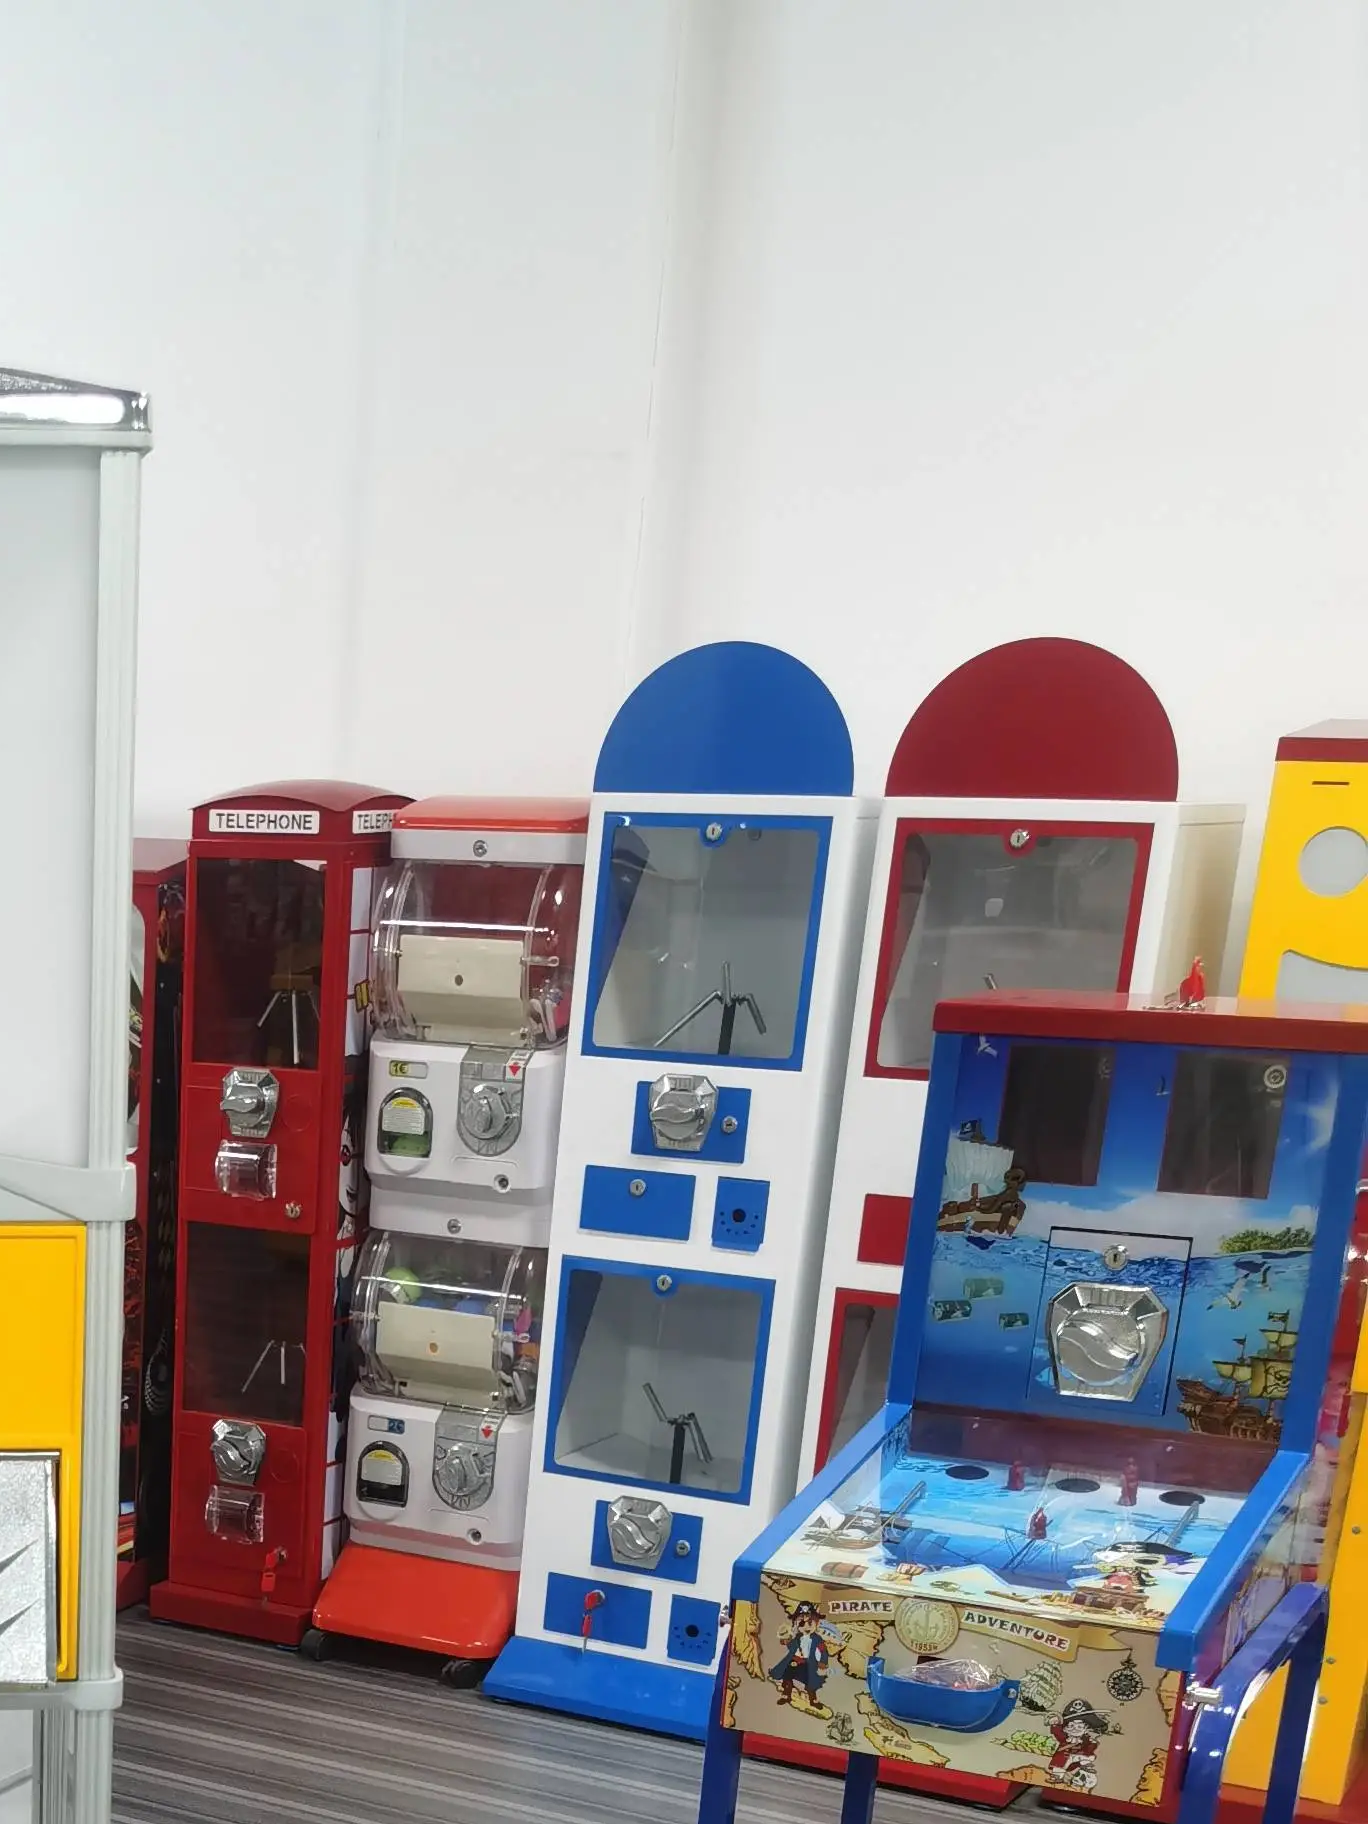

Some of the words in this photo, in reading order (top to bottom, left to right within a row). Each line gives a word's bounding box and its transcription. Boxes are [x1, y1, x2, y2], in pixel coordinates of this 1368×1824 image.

[215, 813, 313, 830] TELEPHONE
[829, 1601, 894, 1614] PIRATE
[963, 1610, 1071, 1650] ADVENTURE
